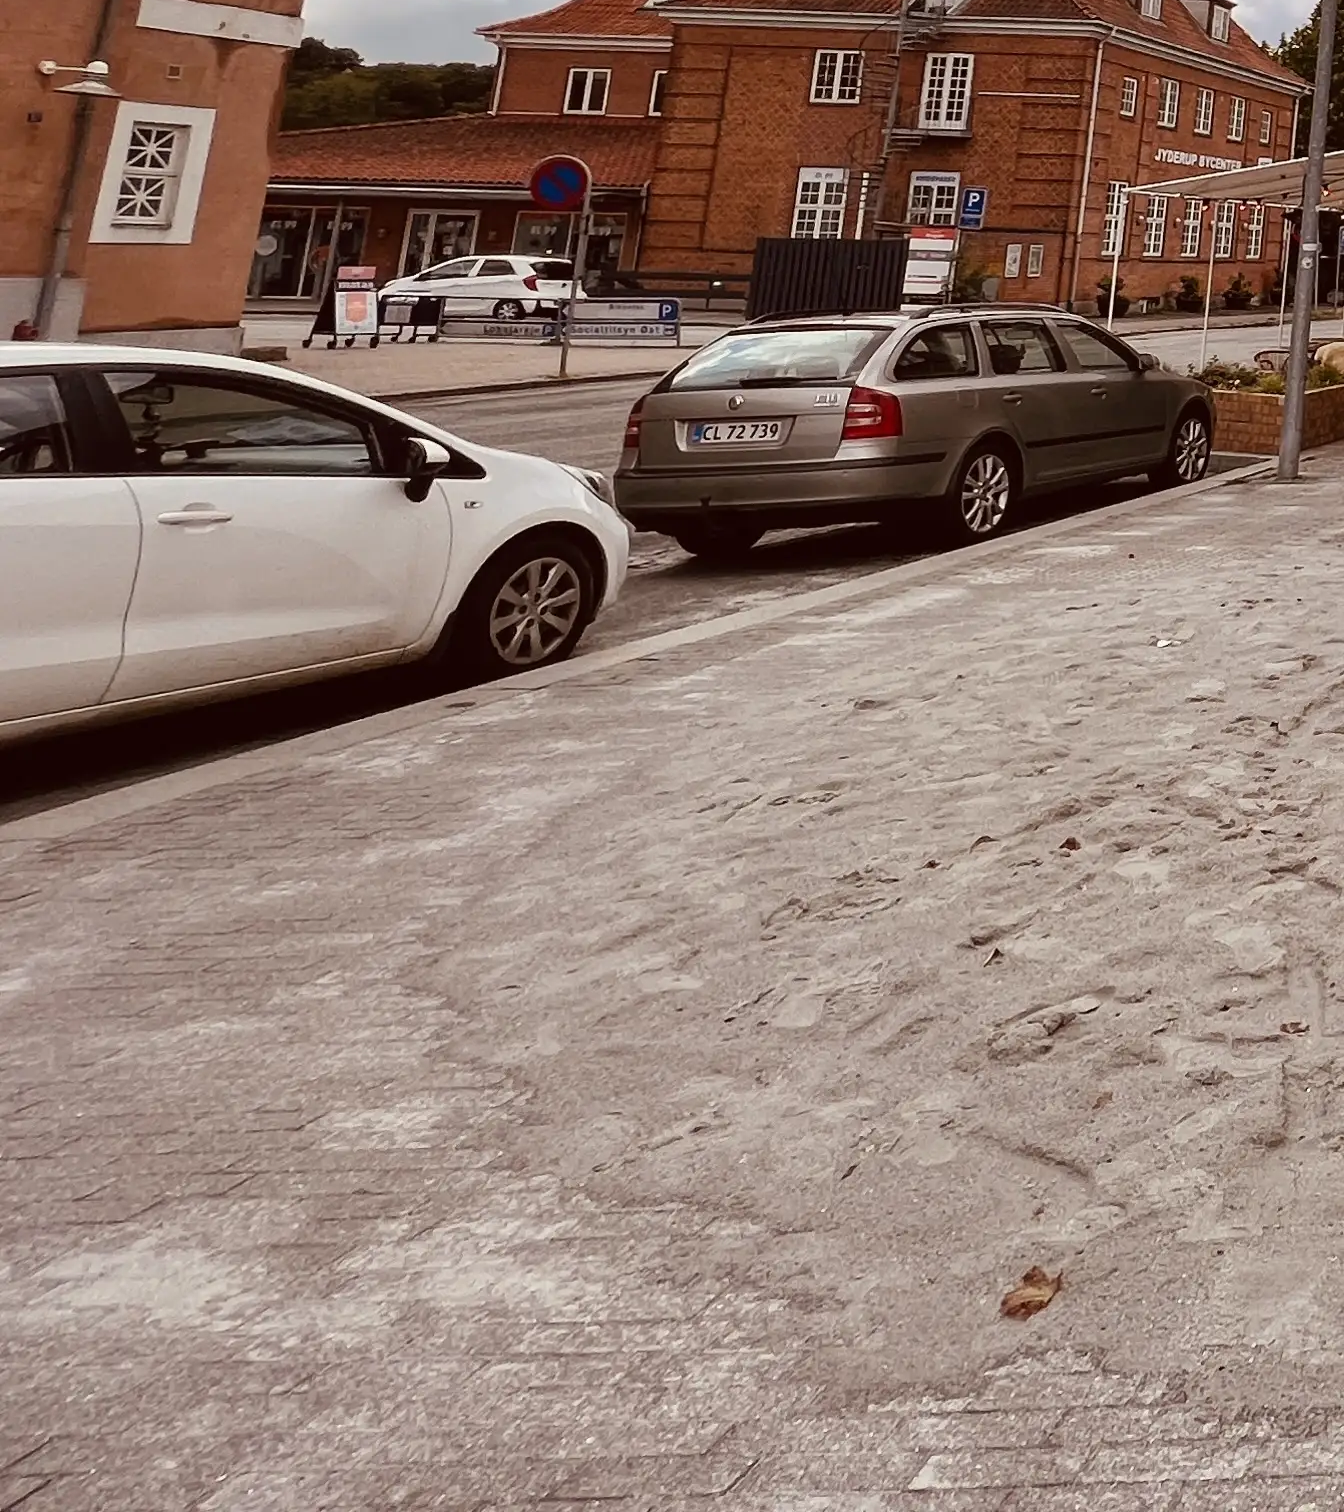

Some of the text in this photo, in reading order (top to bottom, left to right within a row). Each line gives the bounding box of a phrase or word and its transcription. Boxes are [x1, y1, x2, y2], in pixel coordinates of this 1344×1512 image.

[1155, 148, 1198, 167] JYDERUP
[968, 192, 980, 207] P
[662, 304, 672, 317] P
[571, 325, 660, 336] Socialtilsyn Øst
[703, 423, 779, 441] CL 72 739
